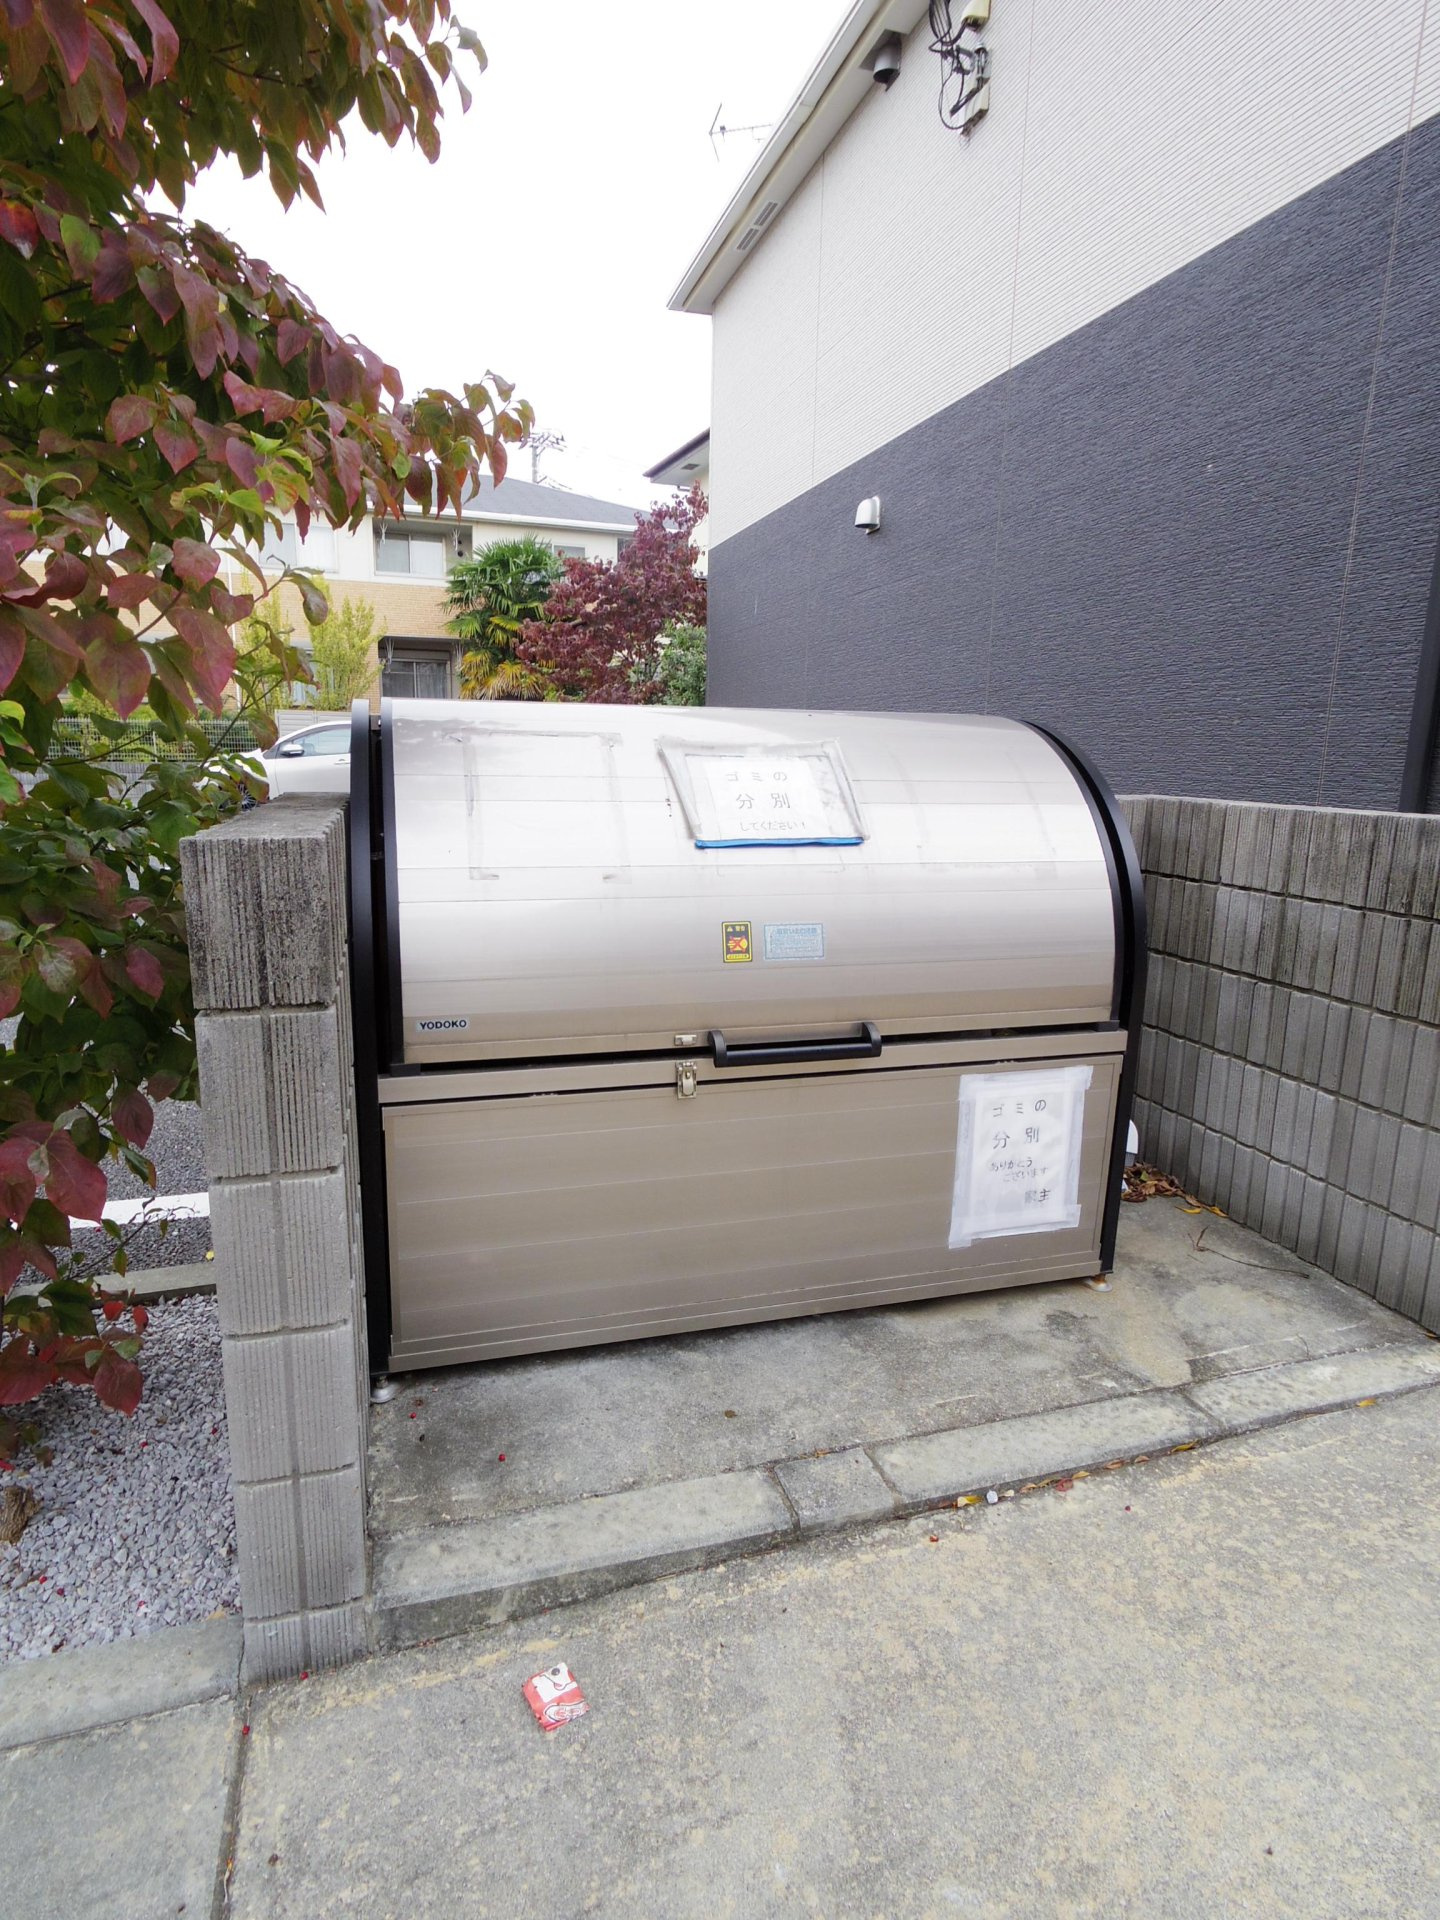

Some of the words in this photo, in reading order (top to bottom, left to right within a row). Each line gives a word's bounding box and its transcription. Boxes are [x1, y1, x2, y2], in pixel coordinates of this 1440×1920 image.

[735, 792, 791, 809] 分別
[420, 1020, 467, 1030] YODOKO
[992, 1127, 1040, 1149] 分別
